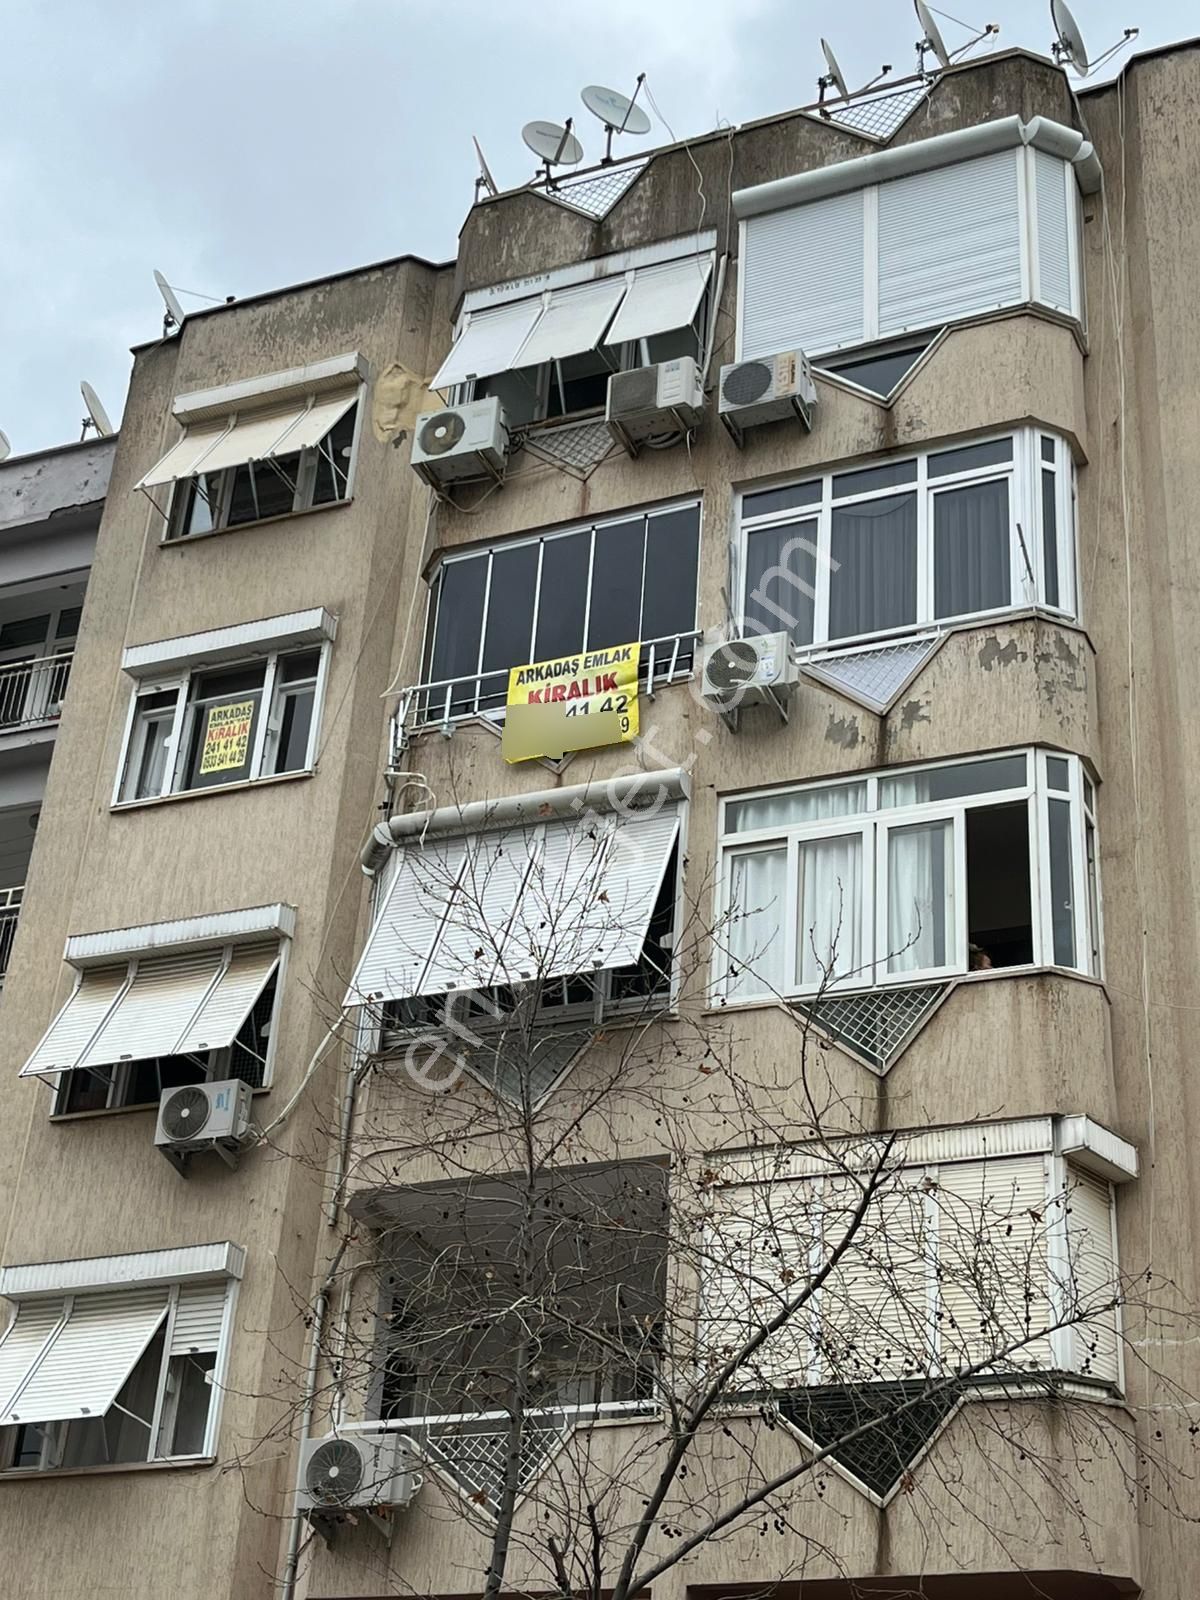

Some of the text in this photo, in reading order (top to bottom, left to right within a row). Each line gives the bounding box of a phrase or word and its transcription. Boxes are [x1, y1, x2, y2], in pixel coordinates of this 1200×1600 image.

[516, 647, 631, 686] ARKADAŞ EMLAK
[528, 671, 618, 704] KİRALIK
[600, 694, 629, 714] 42
[236, 735, 247, 748] 42
